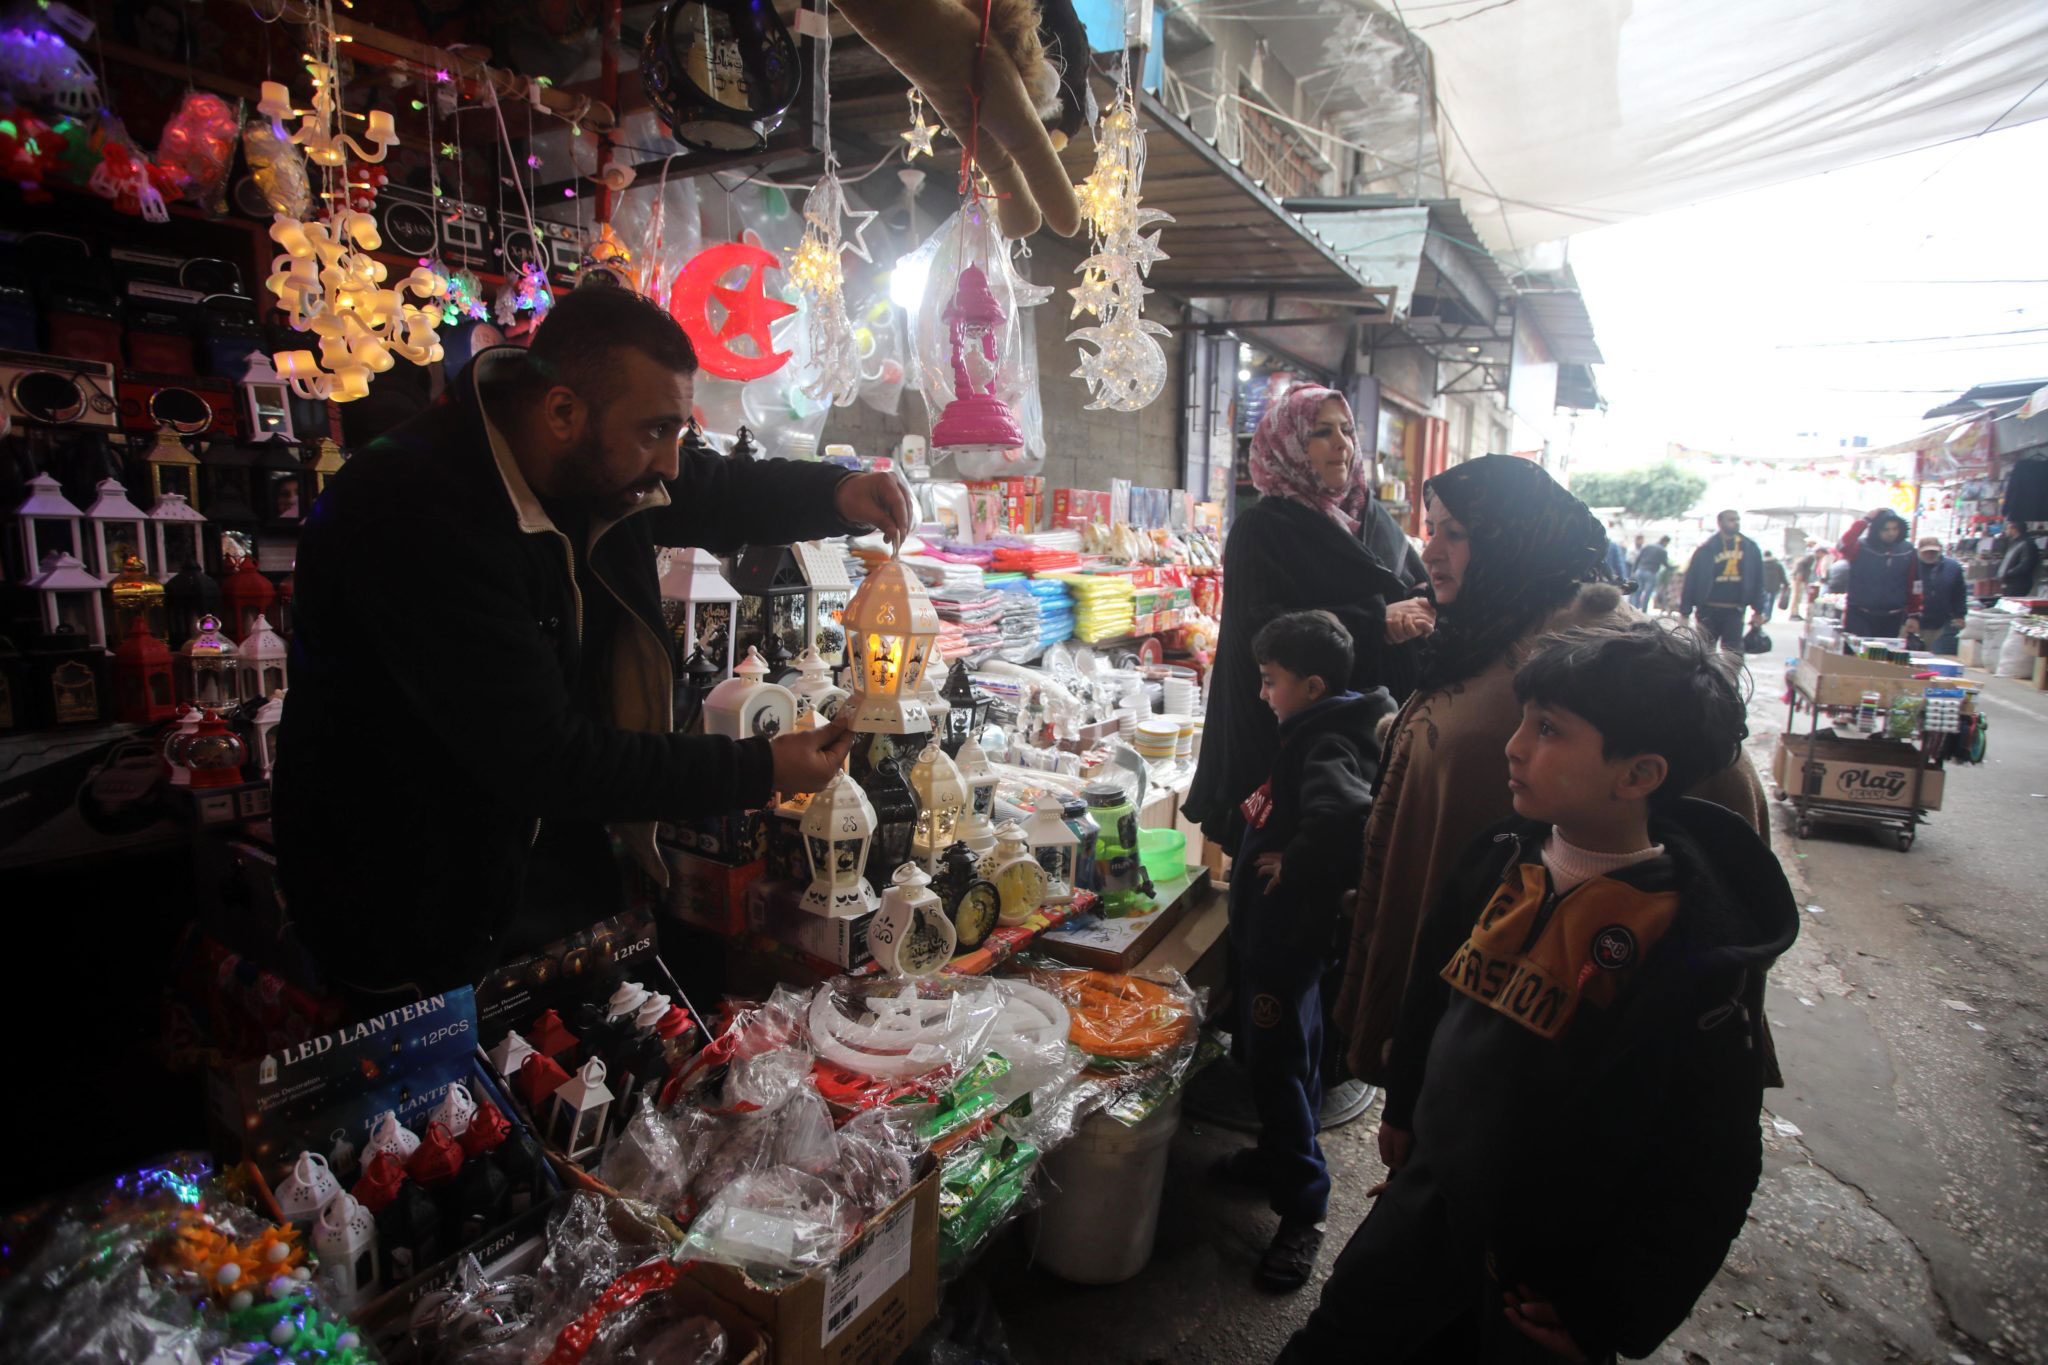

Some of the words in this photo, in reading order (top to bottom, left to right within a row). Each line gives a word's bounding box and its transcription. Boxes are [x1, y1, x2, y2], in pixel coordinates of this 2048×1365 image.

[1839, 769, 1906, 797] Play
[612, 937, 651, 963] 12PCS
[282, 1034, 333, 1067] LED
[338, 994, 447, 1046] LANTERN
[420, 1019, 470, 1048] 12PCS
[398, 1074, 468, 1114] LANTEN
